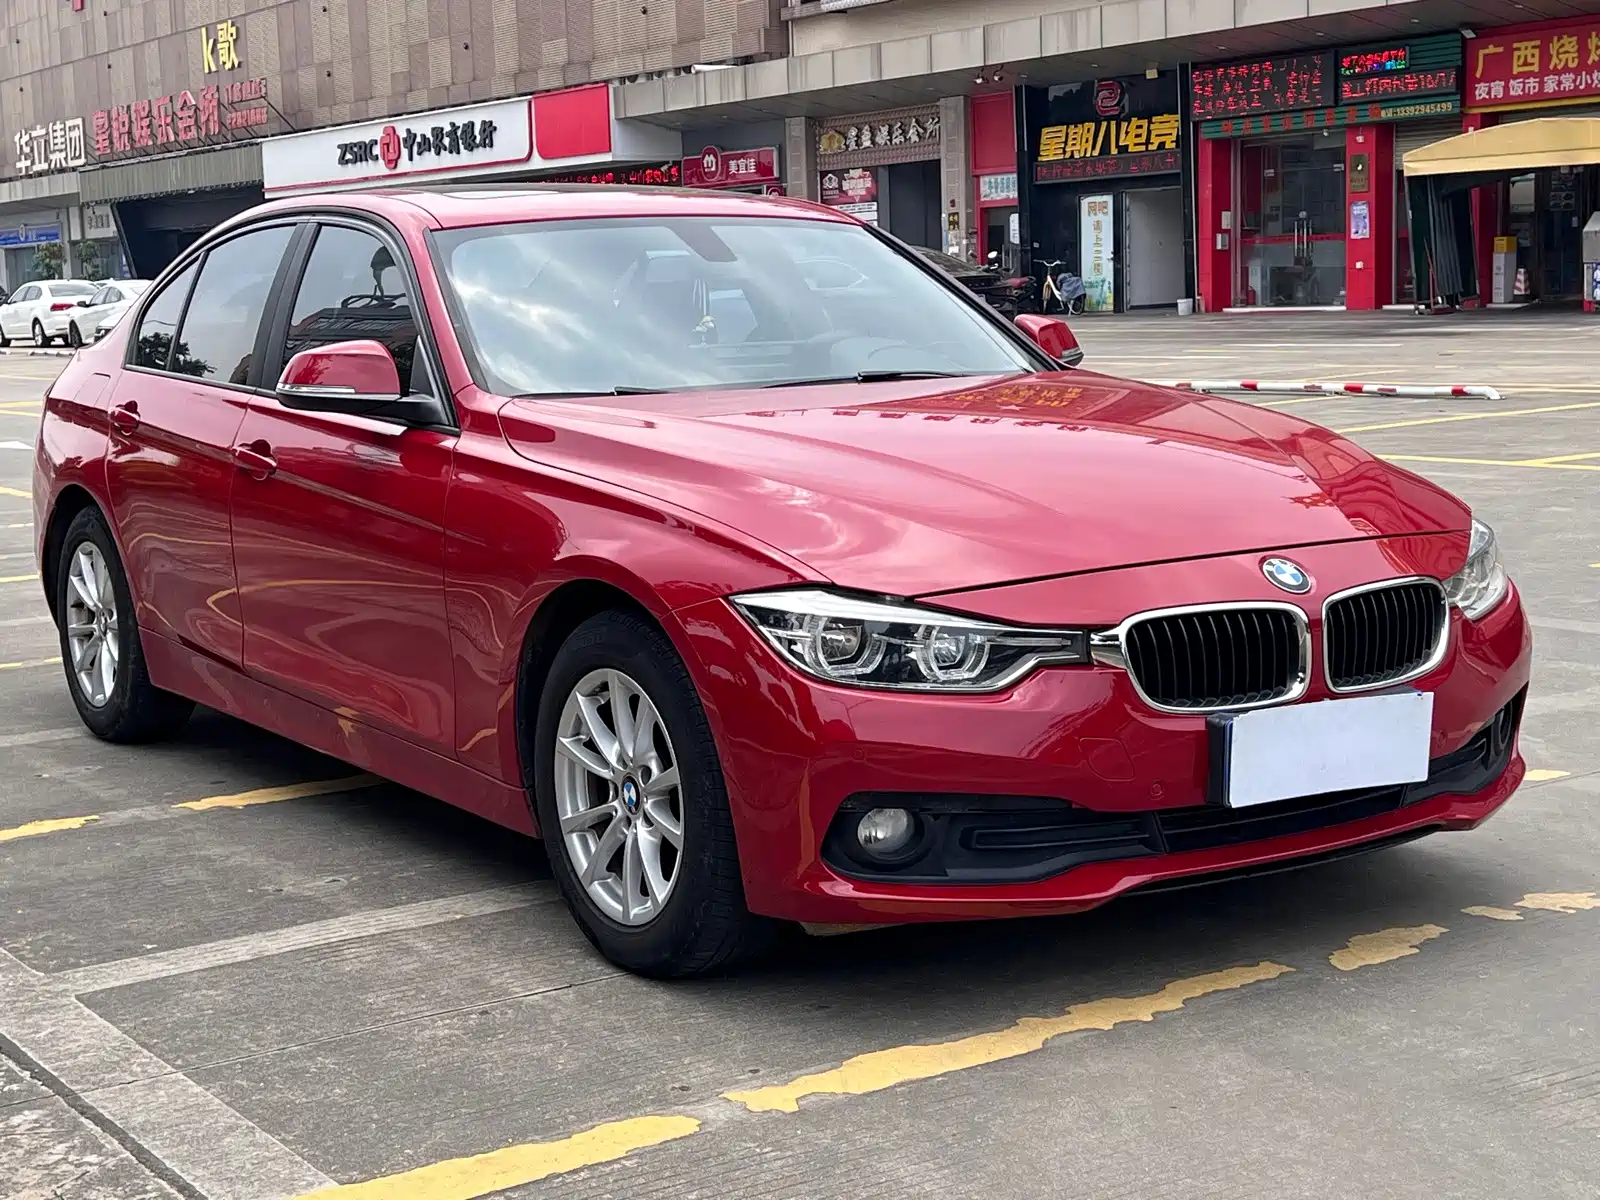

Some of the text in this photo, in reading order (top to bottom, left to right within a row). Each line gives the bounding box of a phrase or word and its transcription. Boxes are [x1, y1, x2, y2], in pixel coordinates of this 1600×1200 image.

[1474, 80, 1505, 100] 夜宵
[1509, 77, 1540, 96] 饭市
[14, 117, 87, 175] 华立集团
[1038, 114, 1180, 161] 星期八电竞
[337, 139, 379, 165] ZSRC
[728, 157, 757, 175] 美宜佳
